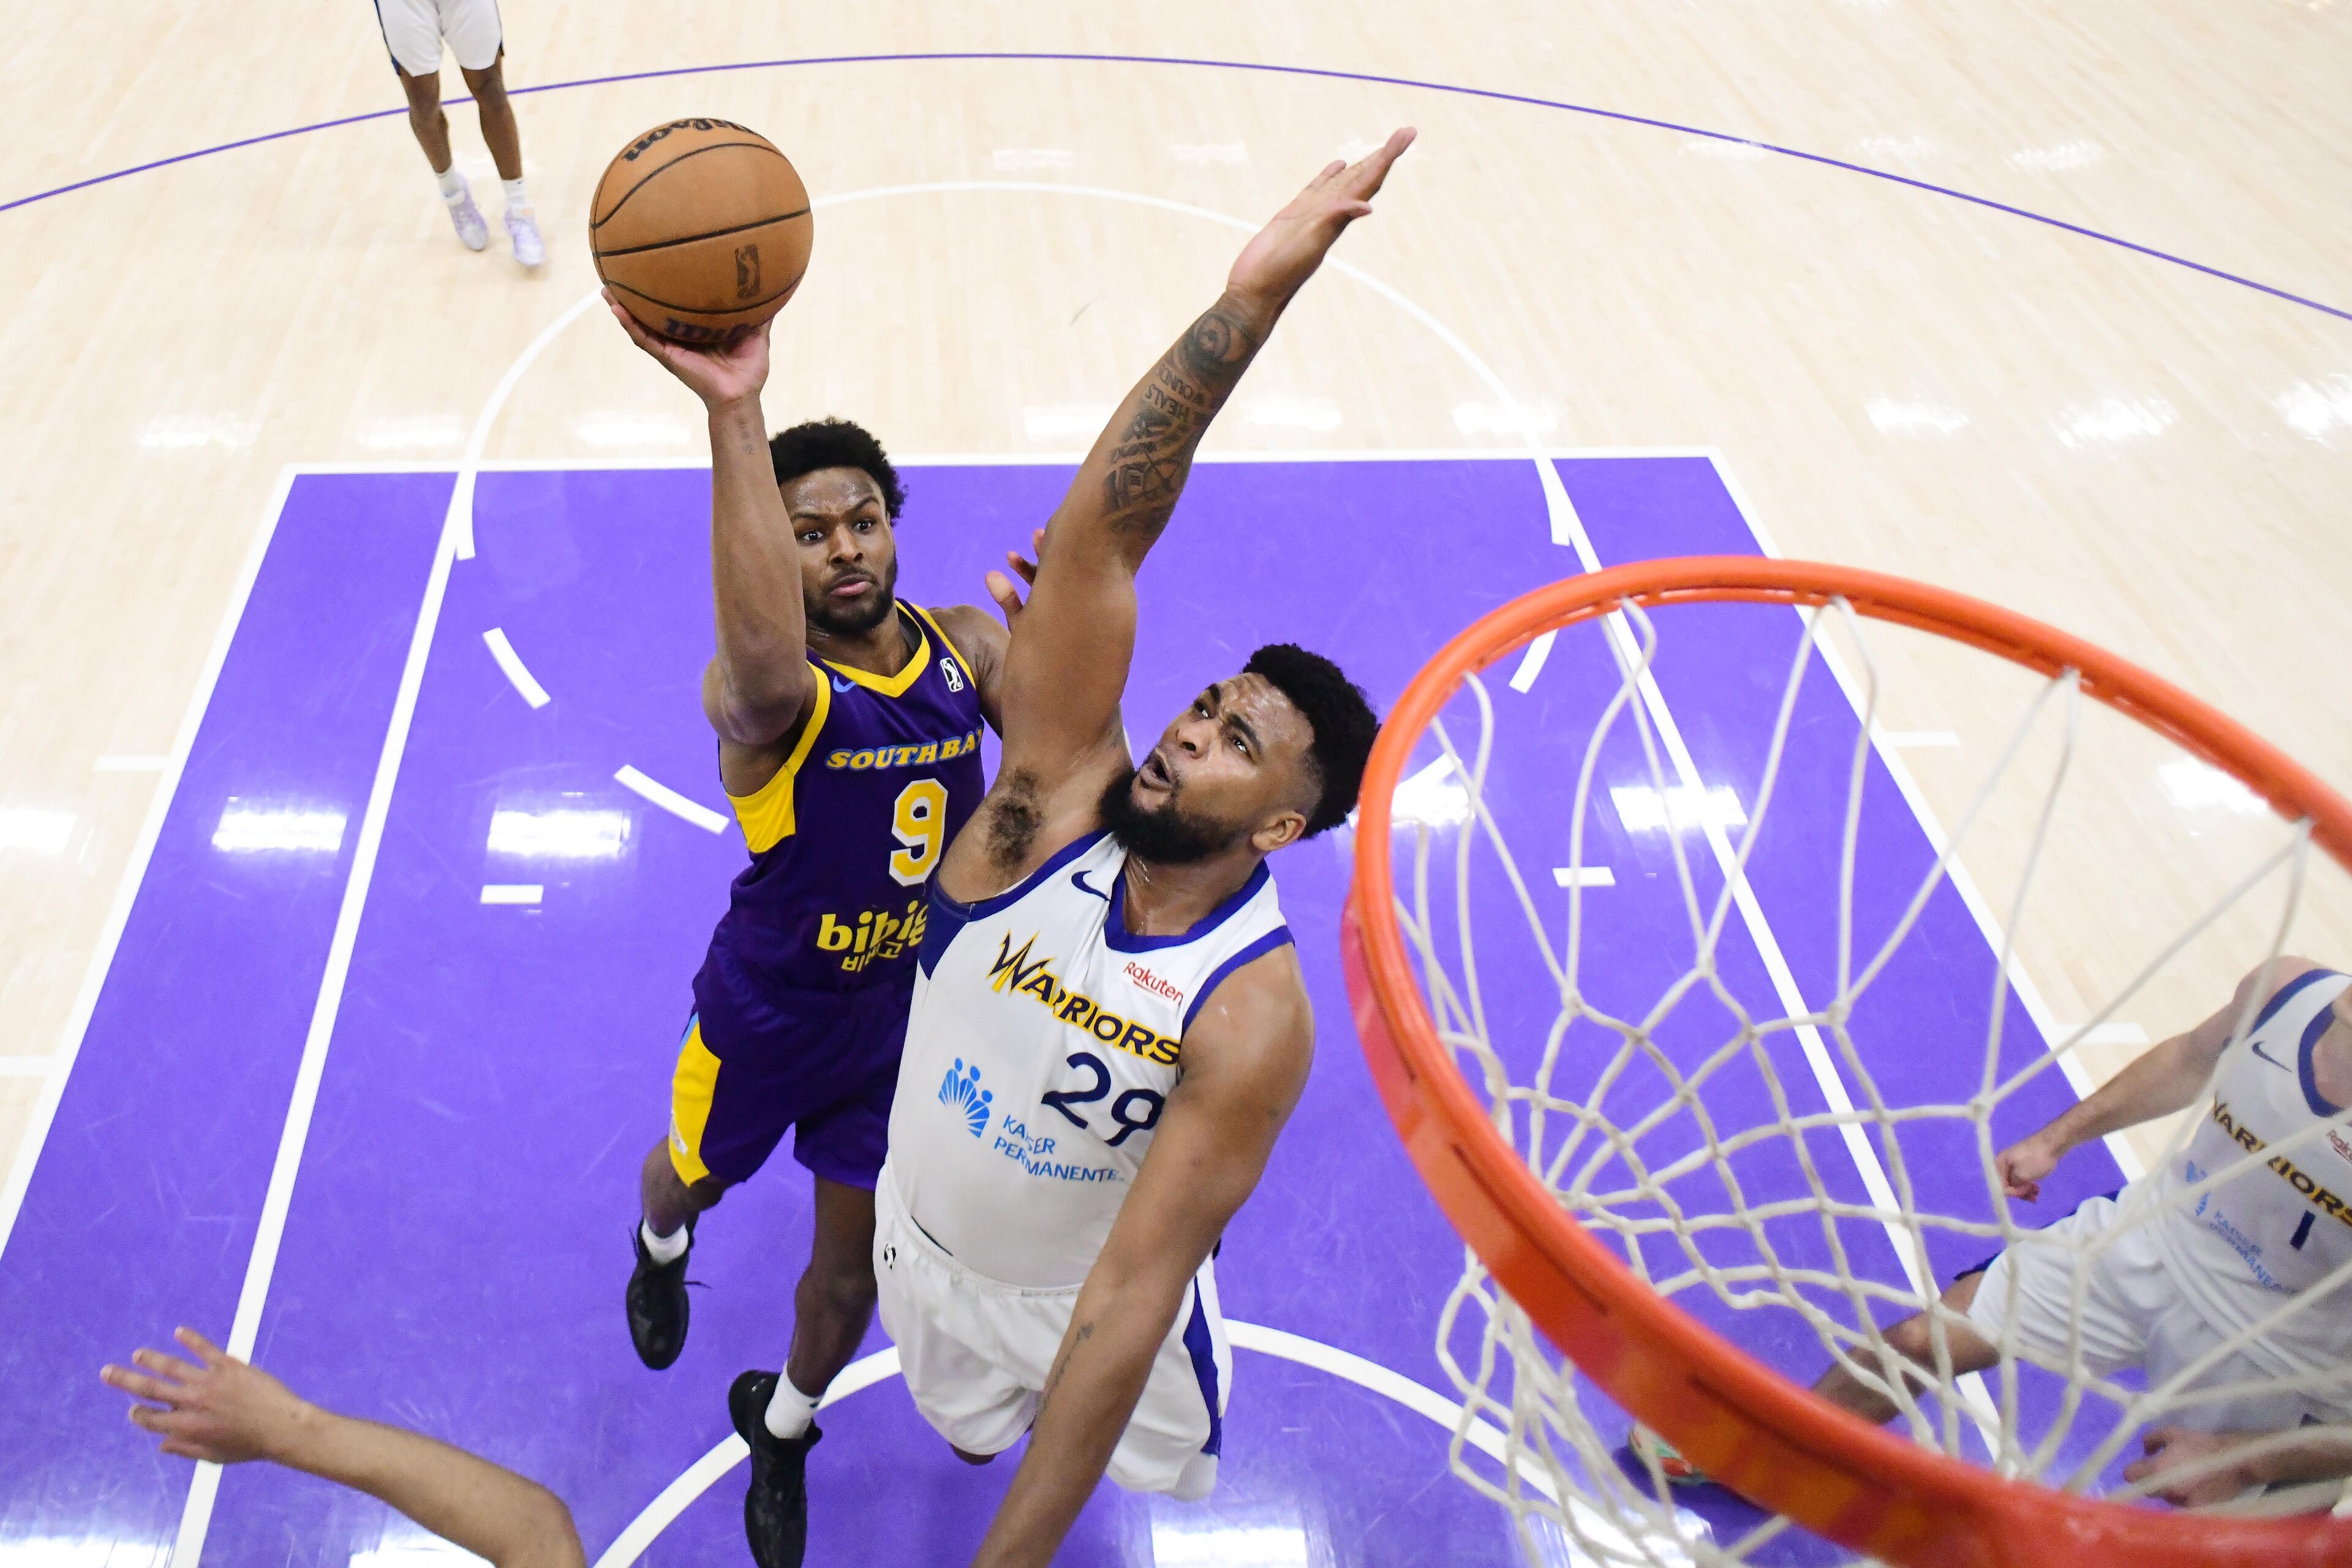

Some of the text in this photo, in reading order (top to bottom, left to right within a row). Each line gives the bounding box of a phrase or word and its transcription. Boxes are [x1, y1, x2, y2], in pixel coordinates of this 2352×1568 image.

[889, 778, 949, 887] 9
[1123, 961, 1184, 1006] Rakuten
[1041, 1052, 1166, 1147] 29
[2290, 1209, 2316, 1251] 1
